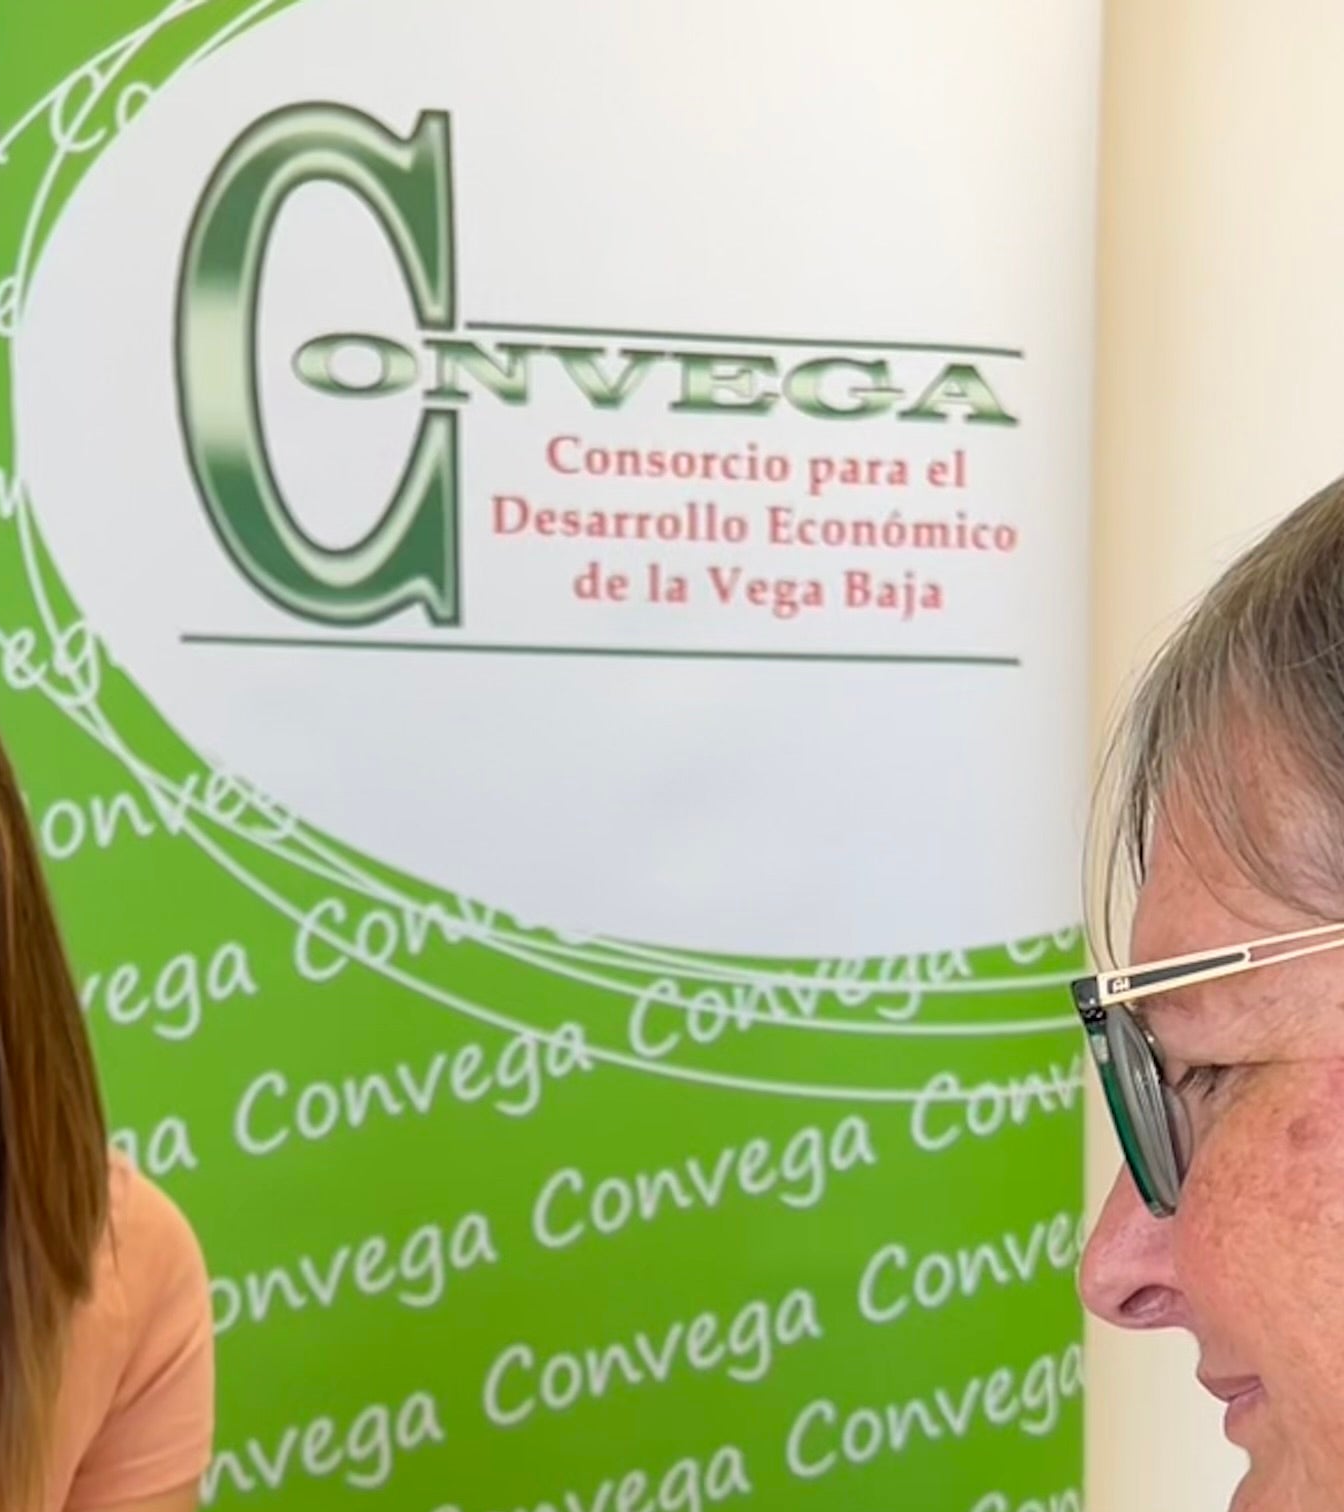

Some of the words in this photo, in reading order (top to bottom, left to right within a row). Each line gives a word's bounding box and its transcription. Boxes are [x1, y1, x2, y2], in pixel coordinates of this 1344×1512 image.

[174, 100, 1023, 628] CONVEGA
[490, 494, 752, 545] Desarrollo
[766, 504, 1020, 557] Económico
[546, 435, 793, 486] Consorcio
[806, 455, 912, 499] para
[925, 450, 969, 490] el
[573, 562, 630, 605] de
[647, 563, 690, 609] la
[708, 566, 826, 620] Vega
[842, 569, 945, 622] Baja
[232, 1021, 593, 1156] Convega
[531, 1115, 879, 1251] Convega
[482, 1287, 824, 1430] Convega
[857, 1211, 1084, 1325] Conve
[785, 1342, 1084, 1481] Convega
